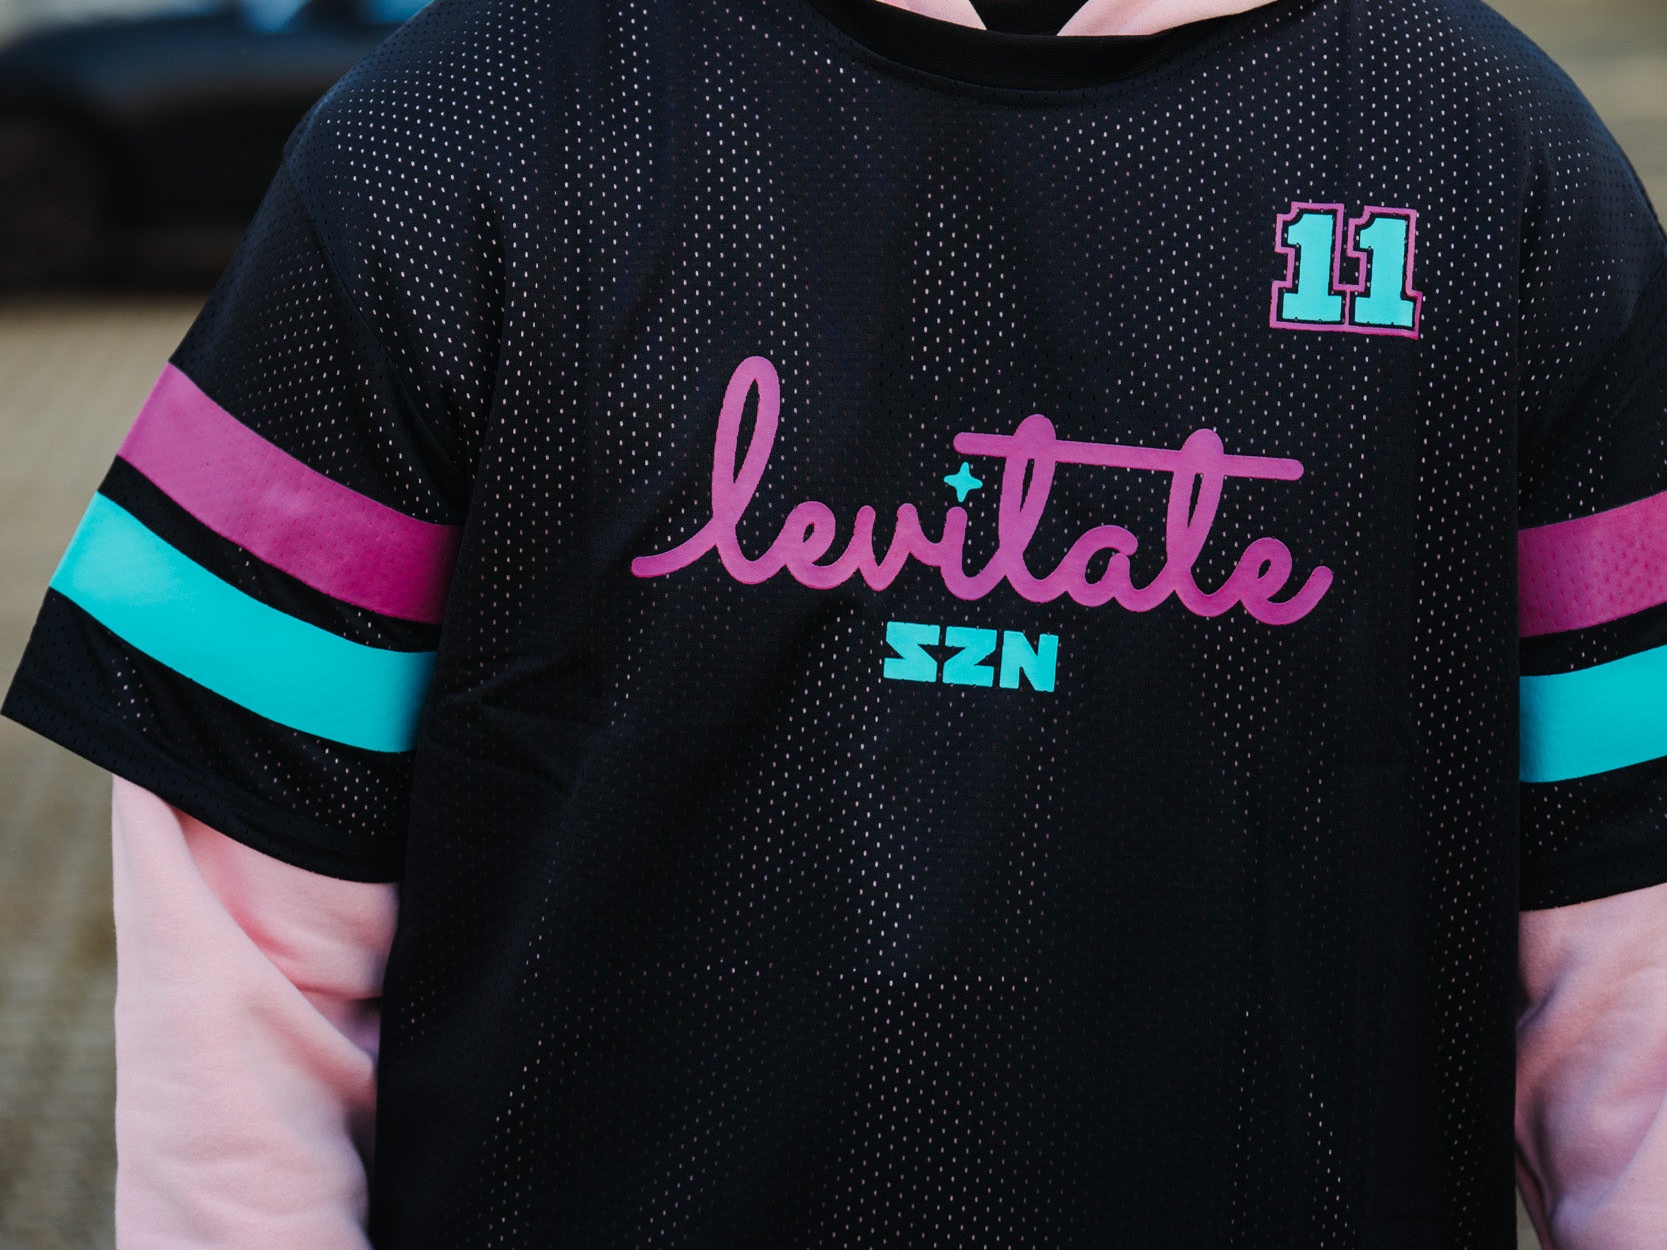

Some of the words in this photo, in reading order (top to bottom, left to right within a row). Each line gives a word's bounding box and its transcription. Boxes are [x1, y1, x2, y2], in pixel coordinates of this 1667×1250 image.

[1269, 201, 1423, 340] 11
[631, 356, 1333, 626] levitate
[882, 620, 1059, 693] SZN
